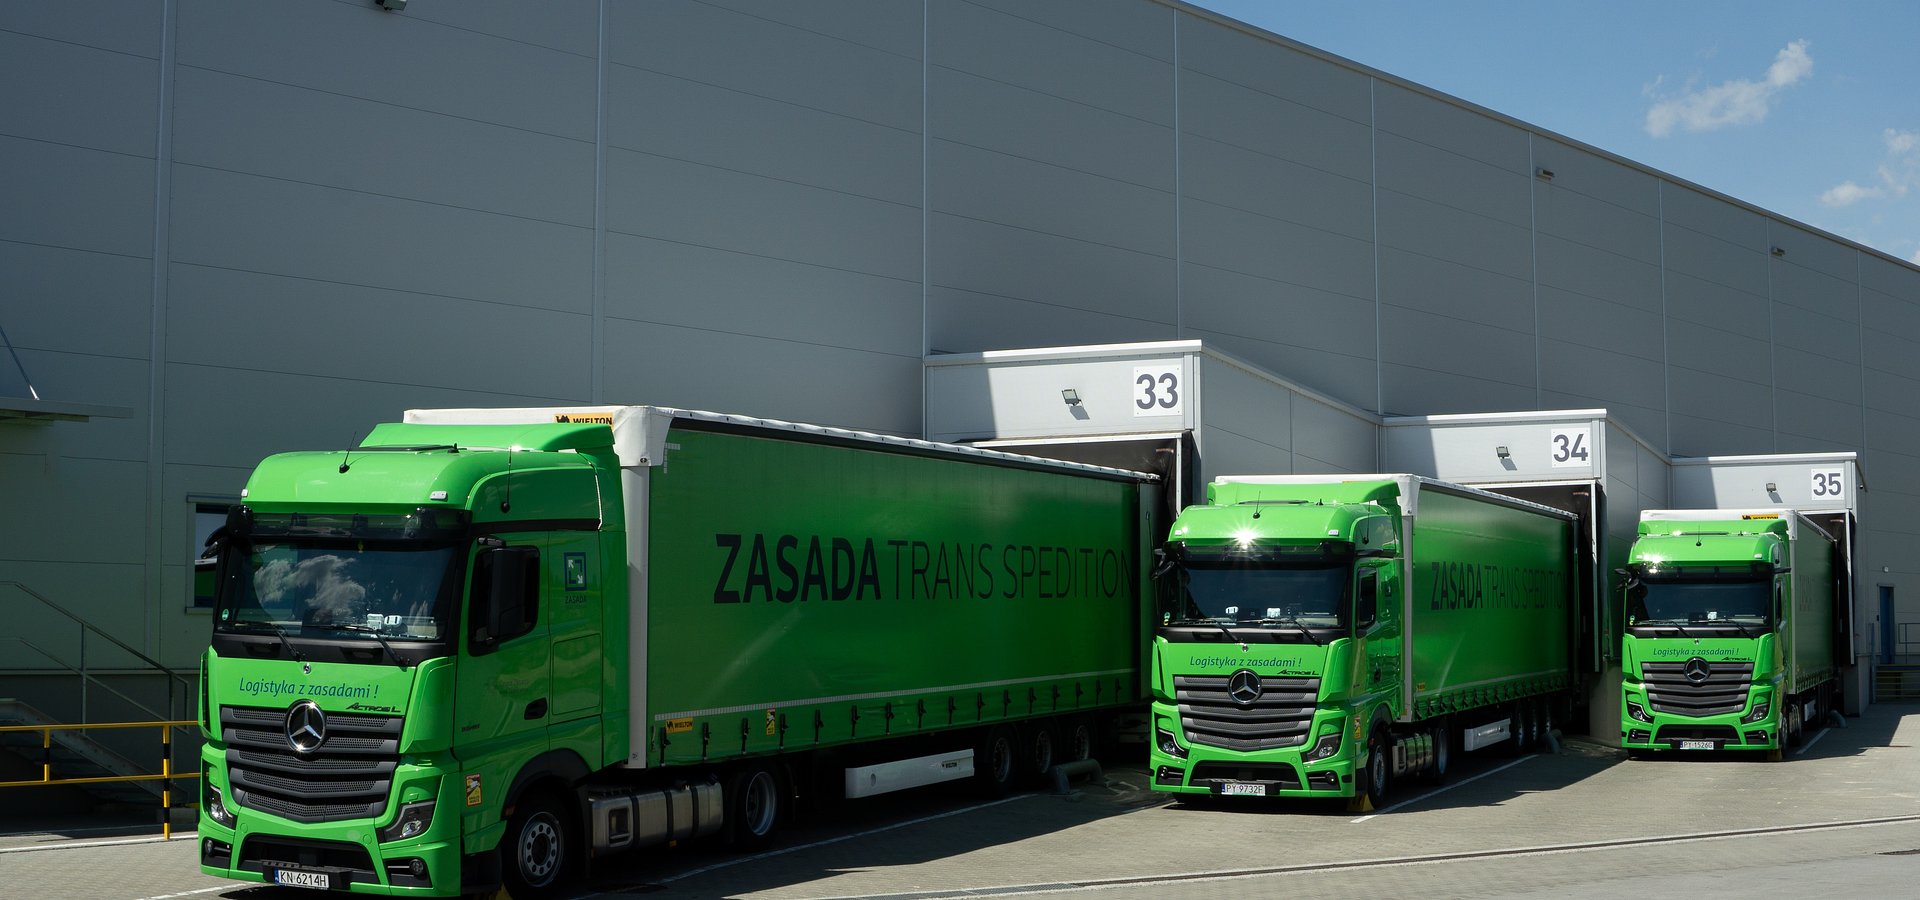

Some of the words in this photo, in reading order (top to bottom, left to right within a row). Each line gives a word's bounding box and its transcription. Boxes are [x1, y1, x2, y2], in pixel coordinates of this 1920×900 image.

[1136, 373, 1178, 409] 33
[1553, 433, 1589, 462] 34
[1813, 473, 1842, 496] 35
[714, 533, 882, 604] ZASADA
[887, 539, 994, 601] TRANS
[1431, 561, 1483, 611] ZASADA
[1485, 565, 1520, 609] TRANS
[1190, 656, 1236, 669] Logistyka
[1238, 659, 1243, 667] z
[1246, 657, 1296, 668] zasadami
[1653, 647, 1689, 658] Logistyka
[1697, 647, 1734, 656] zasadami
[239, 677, 296, 696] Logistyka
[298, 684, 305, 695] z
[308, 683, 370, 698] zasadami
[1226, 784, 1238, 793] PY
[1239, 785, 1263, 794] 9732F
[280, 871, 293, 883] KN
[296, 873, 326, 886] 6214H
